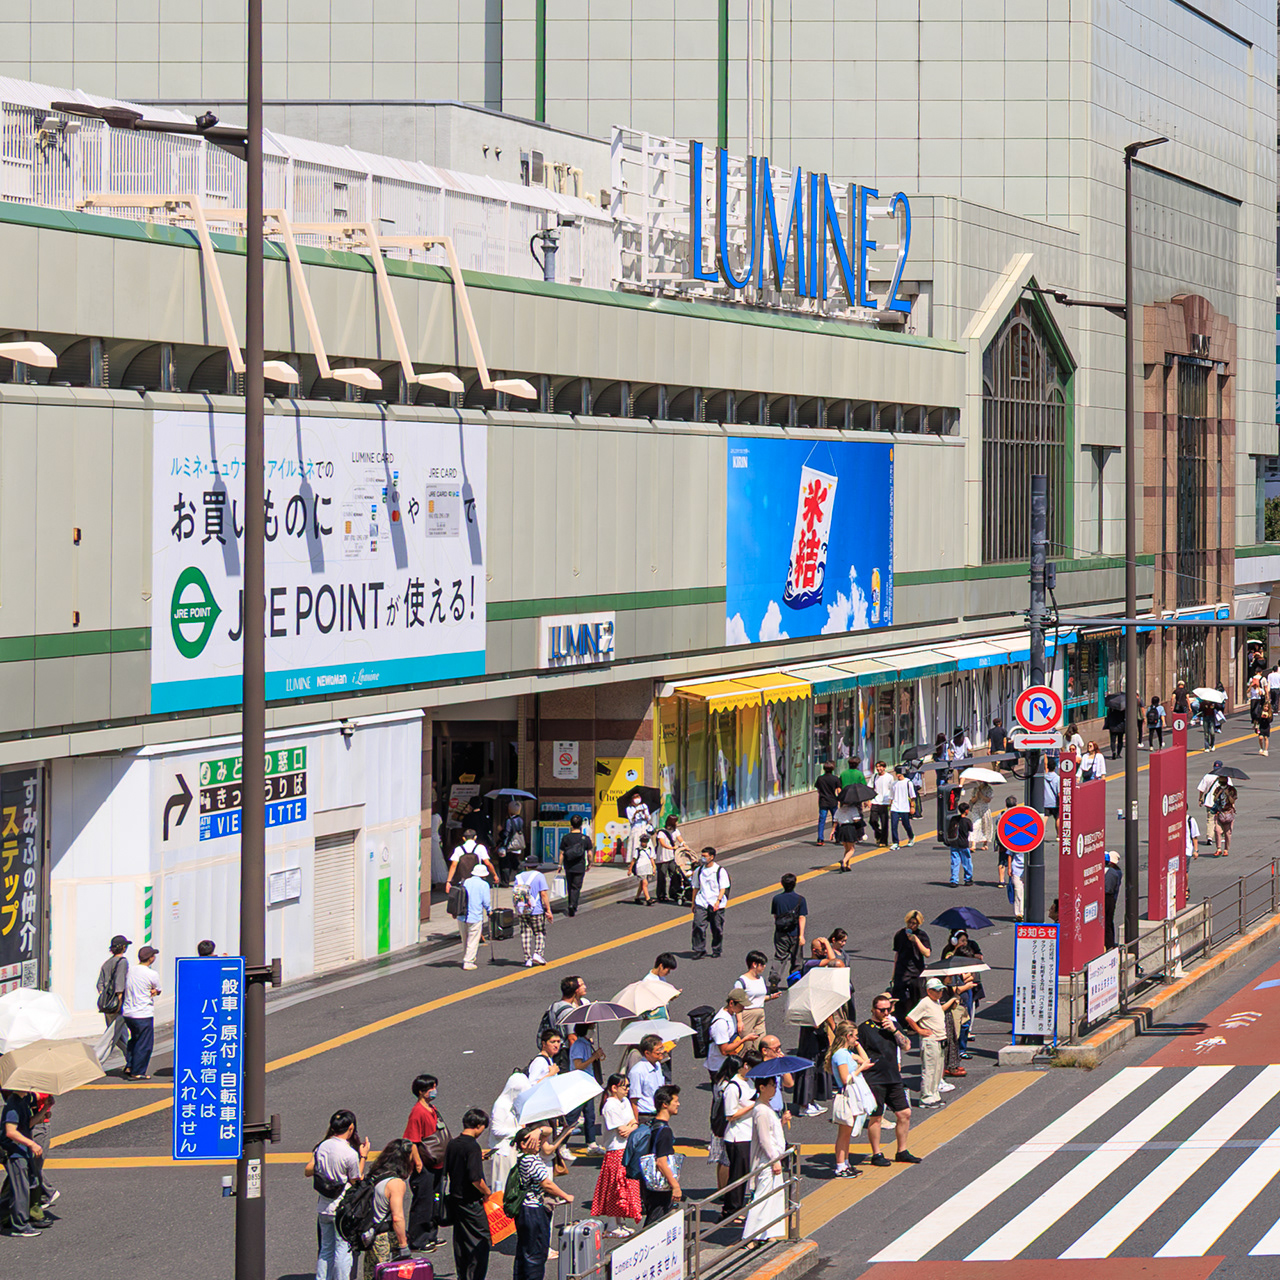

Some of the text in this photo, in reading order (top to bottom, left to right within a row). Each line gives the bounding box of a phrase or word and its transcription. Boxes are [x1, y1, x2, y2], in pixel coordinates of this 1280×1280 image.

[352, 451, 394, 464] LUMINE CARD
[441, 468, 457, 478] CARD
[732, 455, 748, 468] KIRIN
[408, 497, 420, 524] や
[463, 497, 476, 523] で
[794, 478, 828, 589] 氷結
[174, 607, 211, 619] JRE POINT
[228, 586, 287, 641] JE
[286, 676, 311, 692] LUMINE
[216, 747, 304, 782] みどの窓口
[216, 774, 303, 809] きっうりば
[264, 803, 302, 825] LTTE
[1062, 778, 1073, 856] 新宿駅南口周辺案内
[1, 805, 20, 937] ステップ
[19, 776, 38, 954] すみふの仲介
[1018, 927, 1056, 938] お知らせ
[201, 998, 218, 1118] バスタ新宿へは
[219, 966, 239, 1140] 一般車・原付・自転車は
[180, 1068, 198, 1154] 入れません
